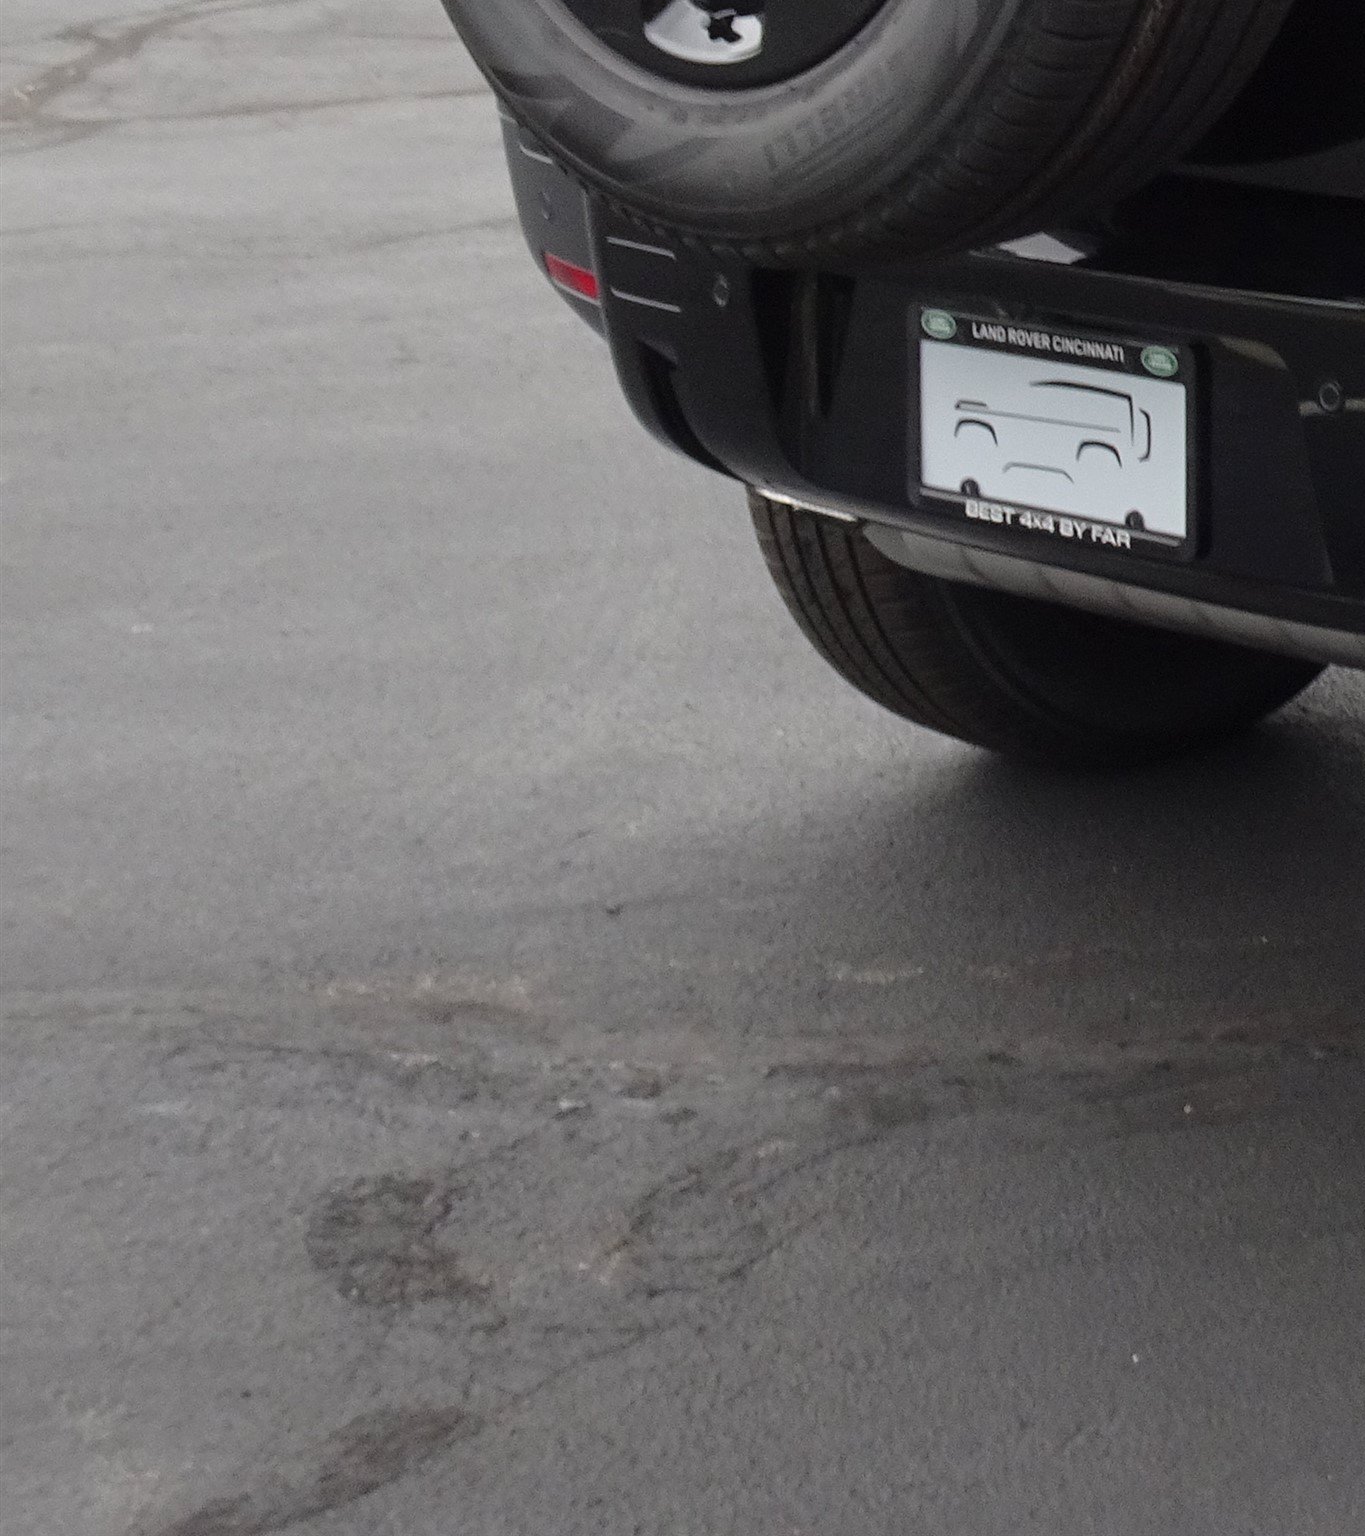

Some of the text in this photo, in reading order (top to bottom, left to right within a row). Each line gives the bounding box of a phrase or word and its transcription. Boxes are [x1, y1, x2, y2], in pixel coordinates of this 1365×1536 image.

[972, 322, 1006, 342] LAND
[1007, 327, 1051, 351] ROVER
[1052, 335, 1125, 363] CINCINNATI
[965, 498, 1016, 524] BEST
[1059, 517, 1087, 539] BY
[1091, 524, 1131, 549] FAR
